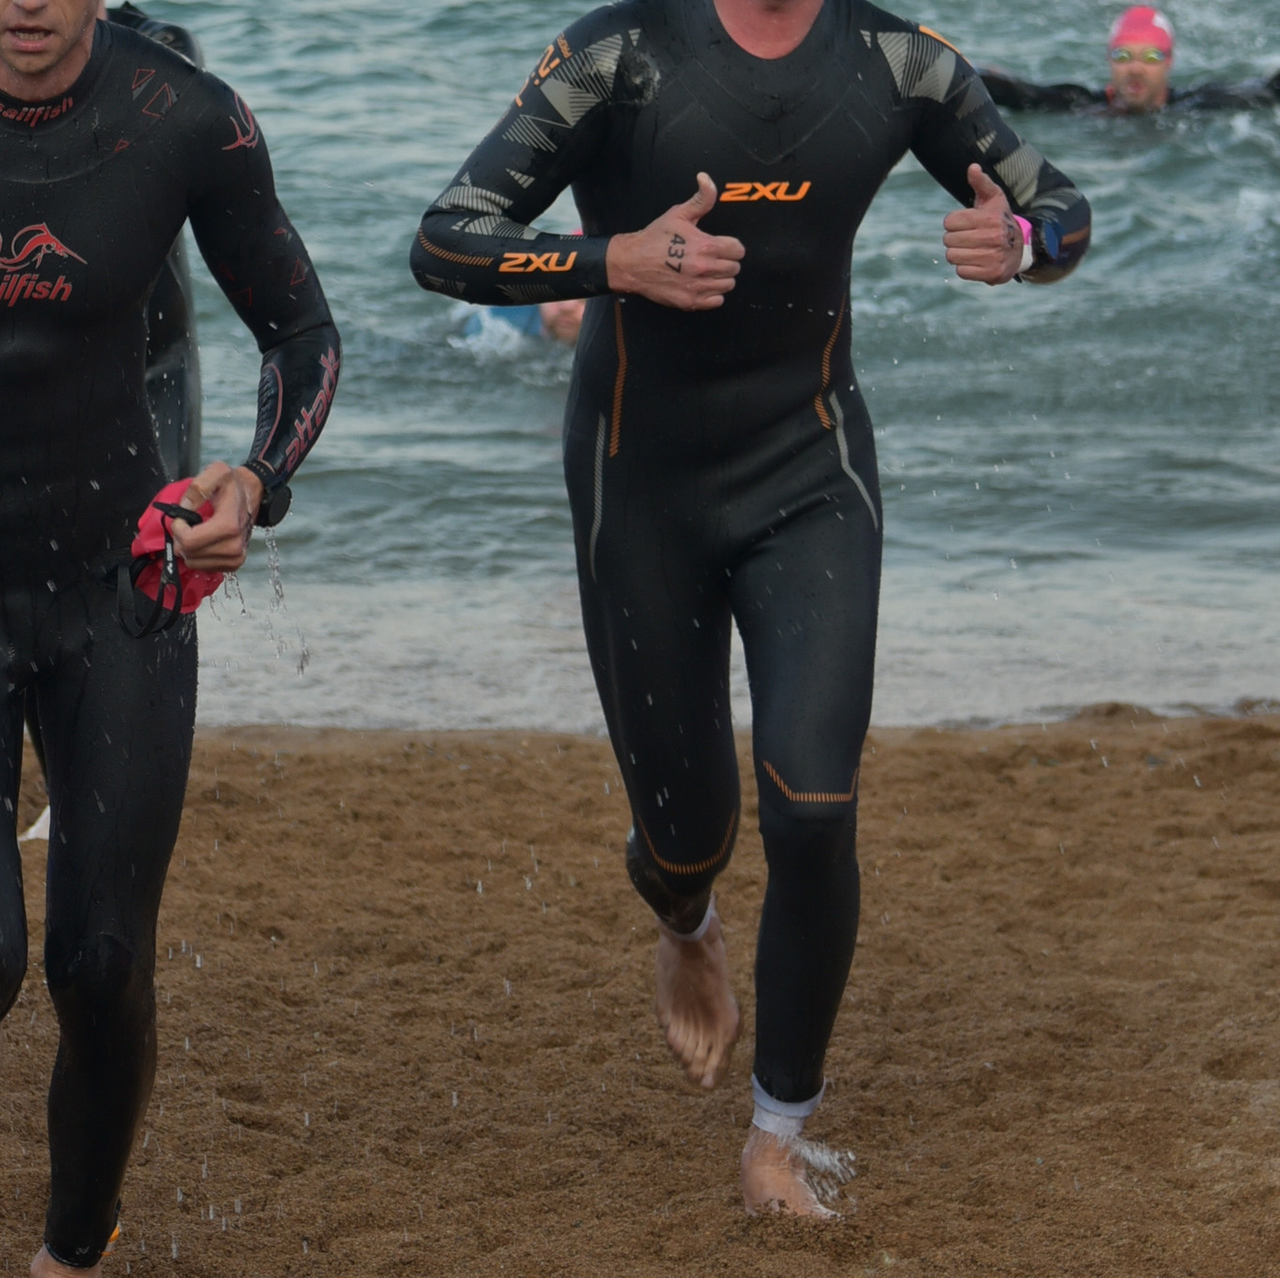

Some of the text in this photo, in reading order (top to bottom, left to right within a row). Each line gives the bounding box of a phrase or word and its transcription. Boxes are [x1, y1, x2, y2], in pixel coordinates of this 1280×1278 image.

[720, 180, 812, 202] 2XU
[498, 251, 577, 273] 2XU
[664, 233, 686, 274] 437
